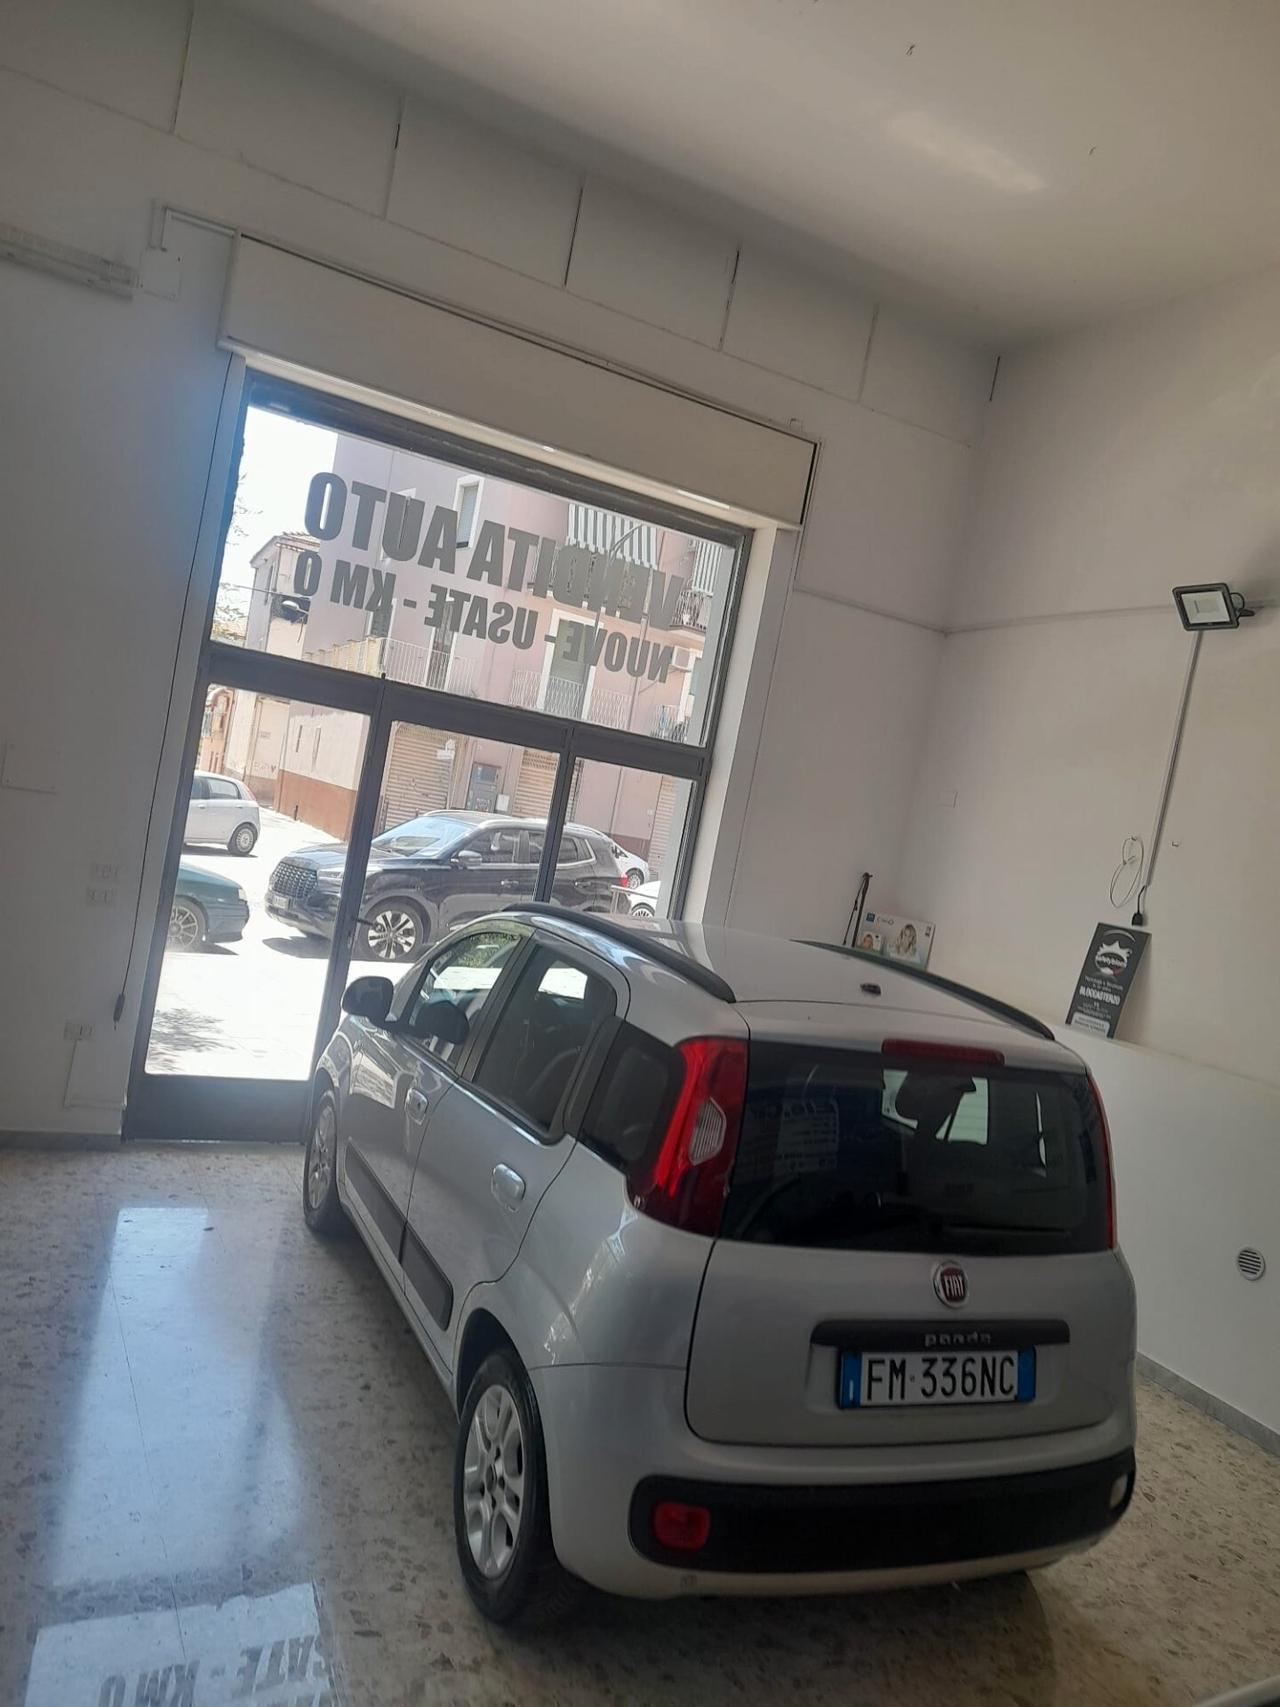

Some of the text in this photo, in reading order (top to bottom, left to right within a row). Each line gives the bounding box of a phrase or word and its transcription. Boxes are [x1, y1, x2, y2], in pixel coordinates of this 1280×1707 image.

[943, 1274, 965, 1298] FIAT
[867, 1355, 1016, 1401] FM 336NC
